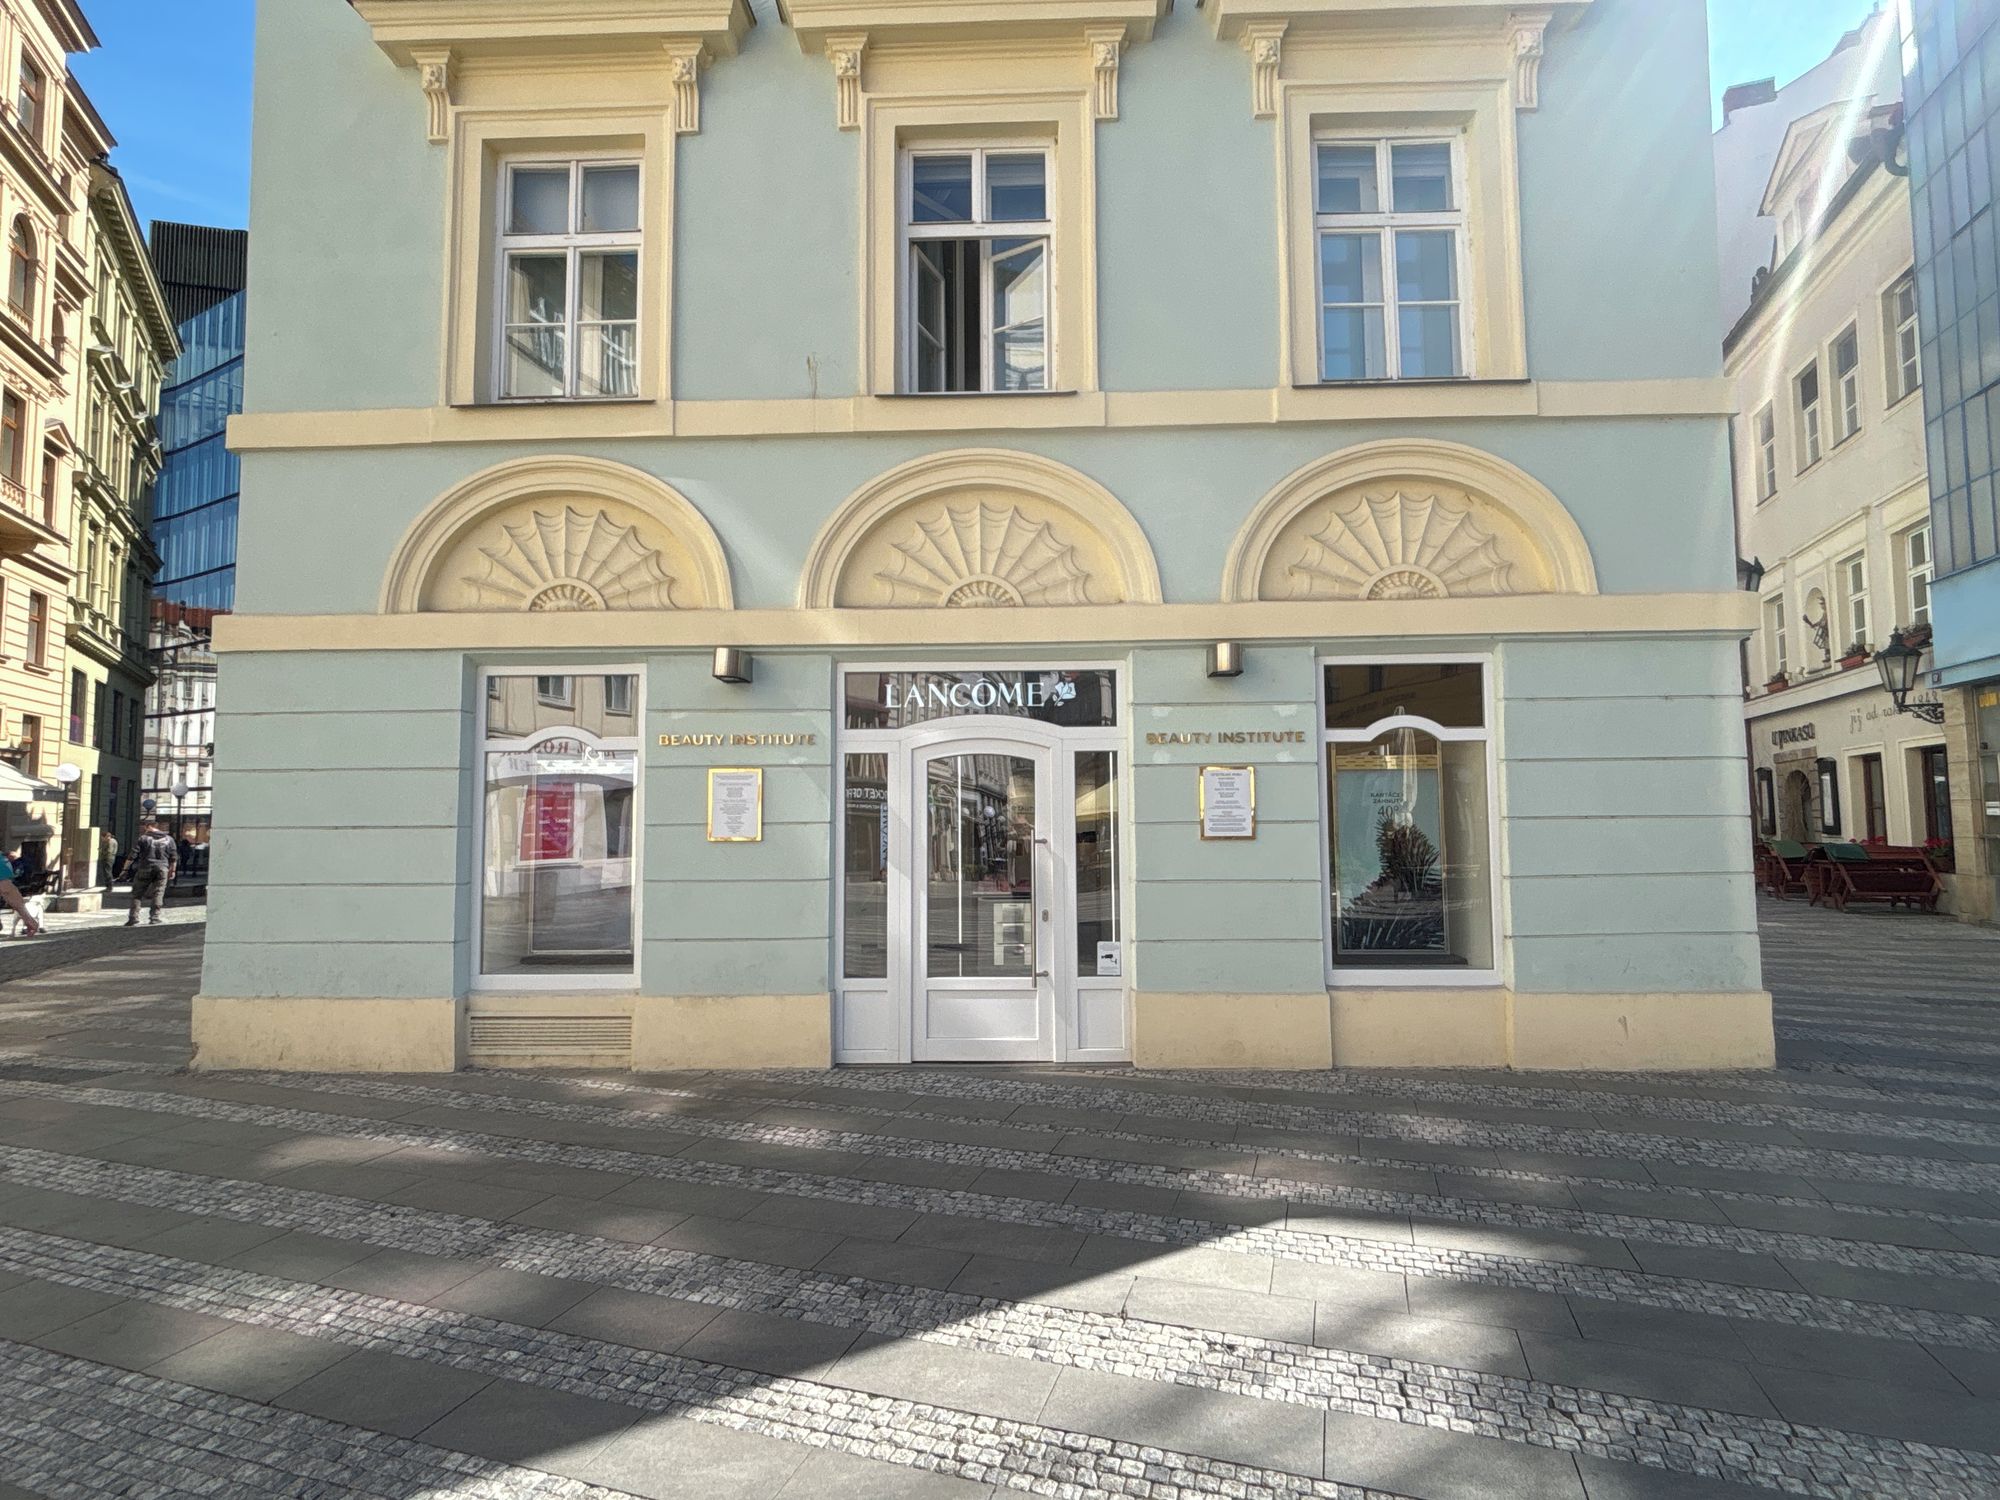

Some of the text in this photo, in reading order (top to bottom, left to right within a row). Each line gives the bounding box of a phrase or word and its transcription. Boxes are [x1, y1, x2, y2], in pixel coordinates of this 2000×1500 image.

[884, 677, 1044, 708] LANCÔME
[658, 733, 816, 746] BEAUTY INSTITUTE
[1145, 730, 1305, 745] BEAUTY INSTITUTE
